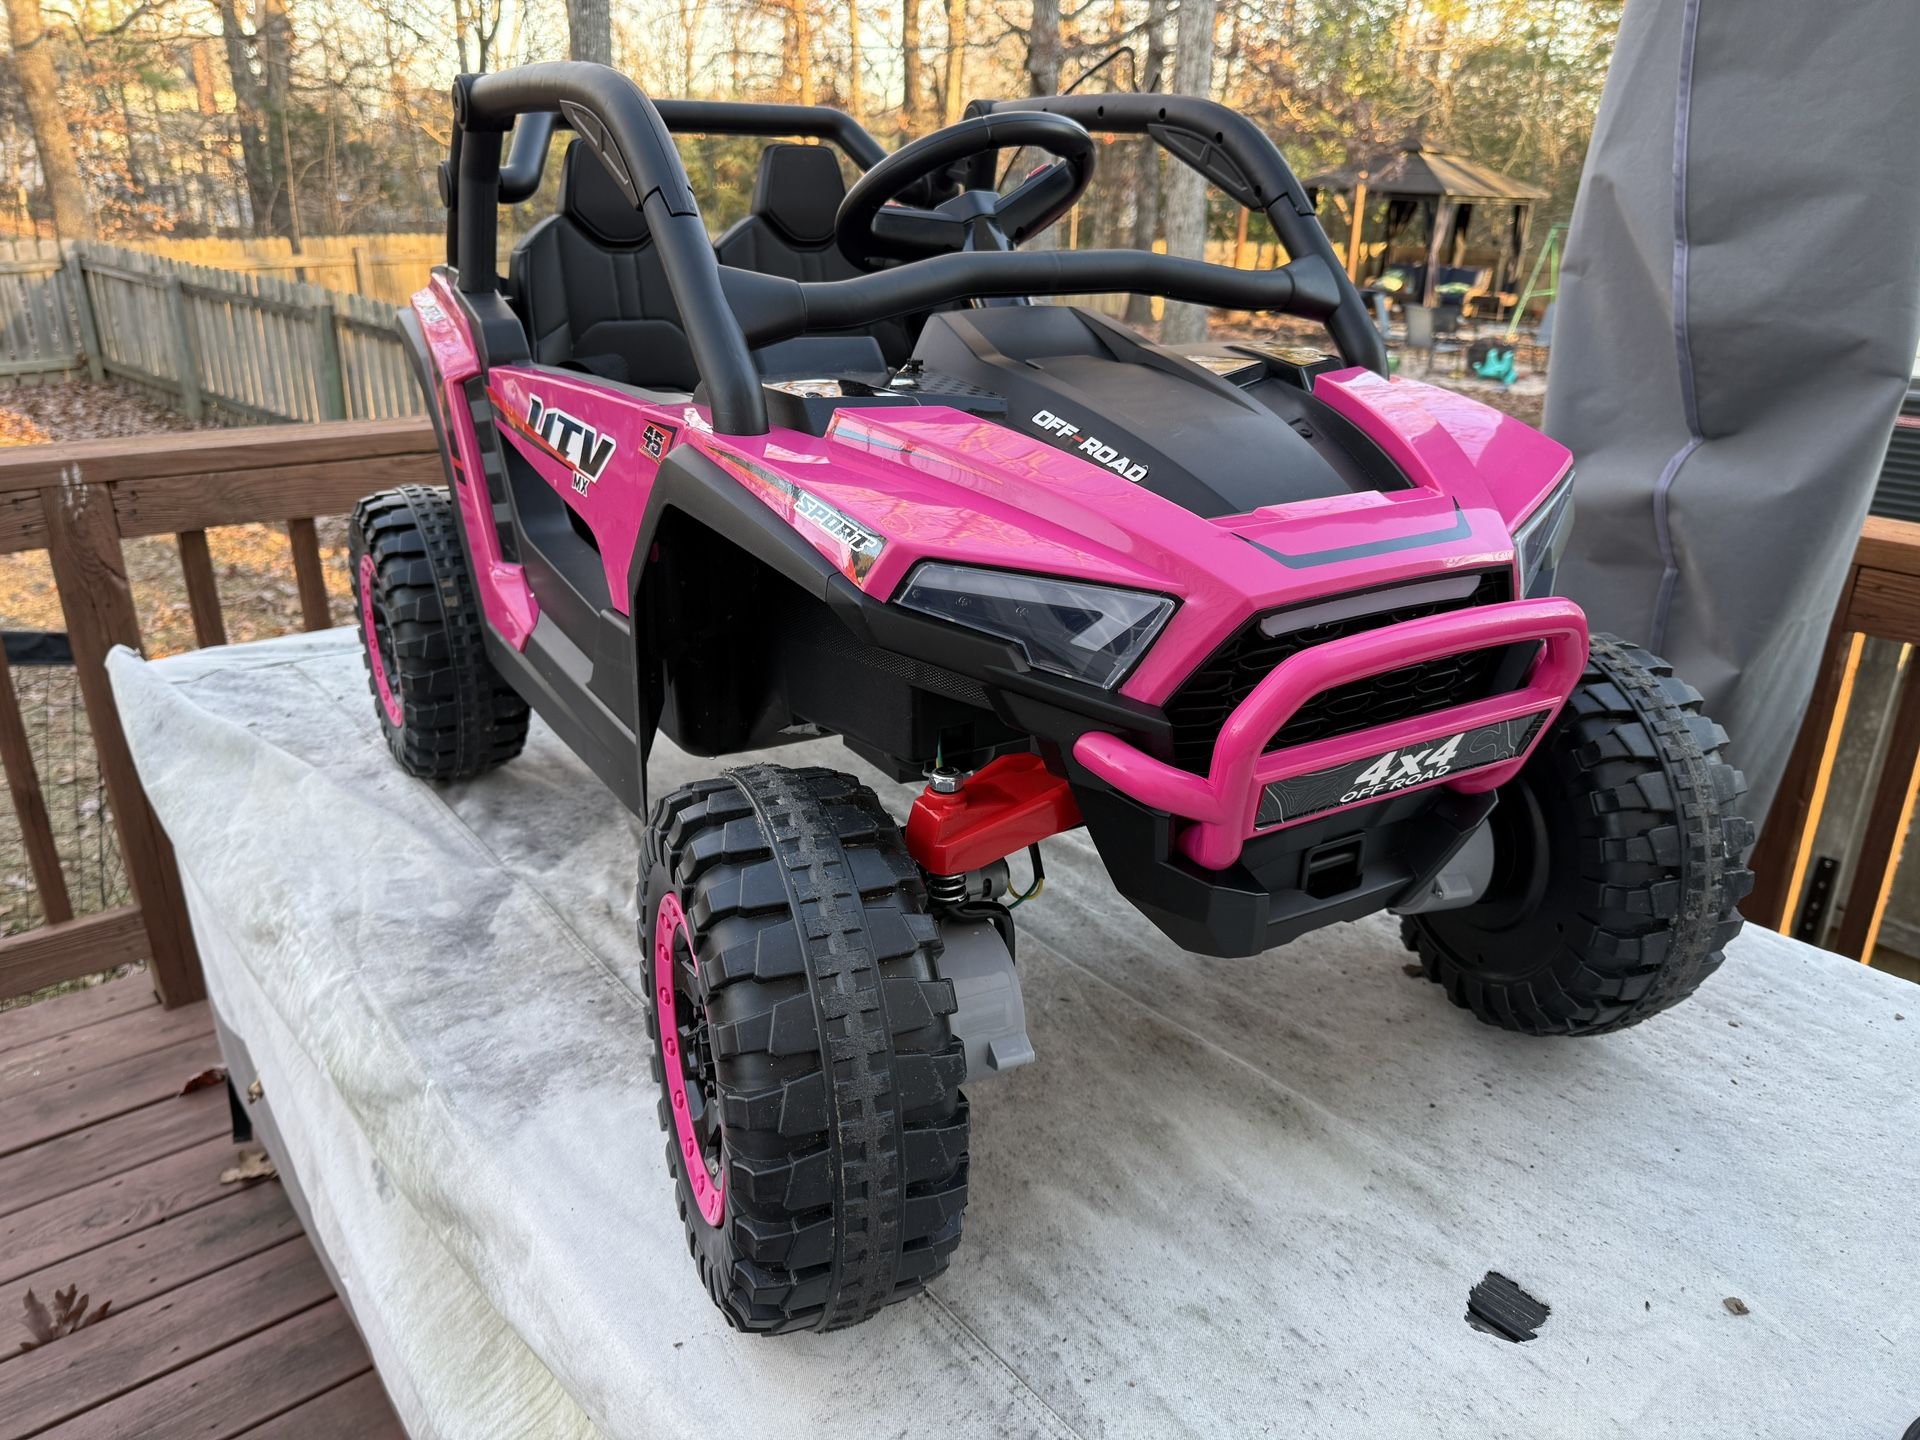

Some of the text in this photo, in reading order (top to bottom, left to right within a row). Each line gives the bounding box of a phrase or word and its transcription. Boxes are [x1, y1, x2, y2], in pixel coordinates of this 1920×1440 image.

[527, 393, 616, 482] UTV
[572, 470, 590, 497] MX
[794, 493, 877, 552] SPORT
[1339, 765, 1451, 803] OFF ROAD
